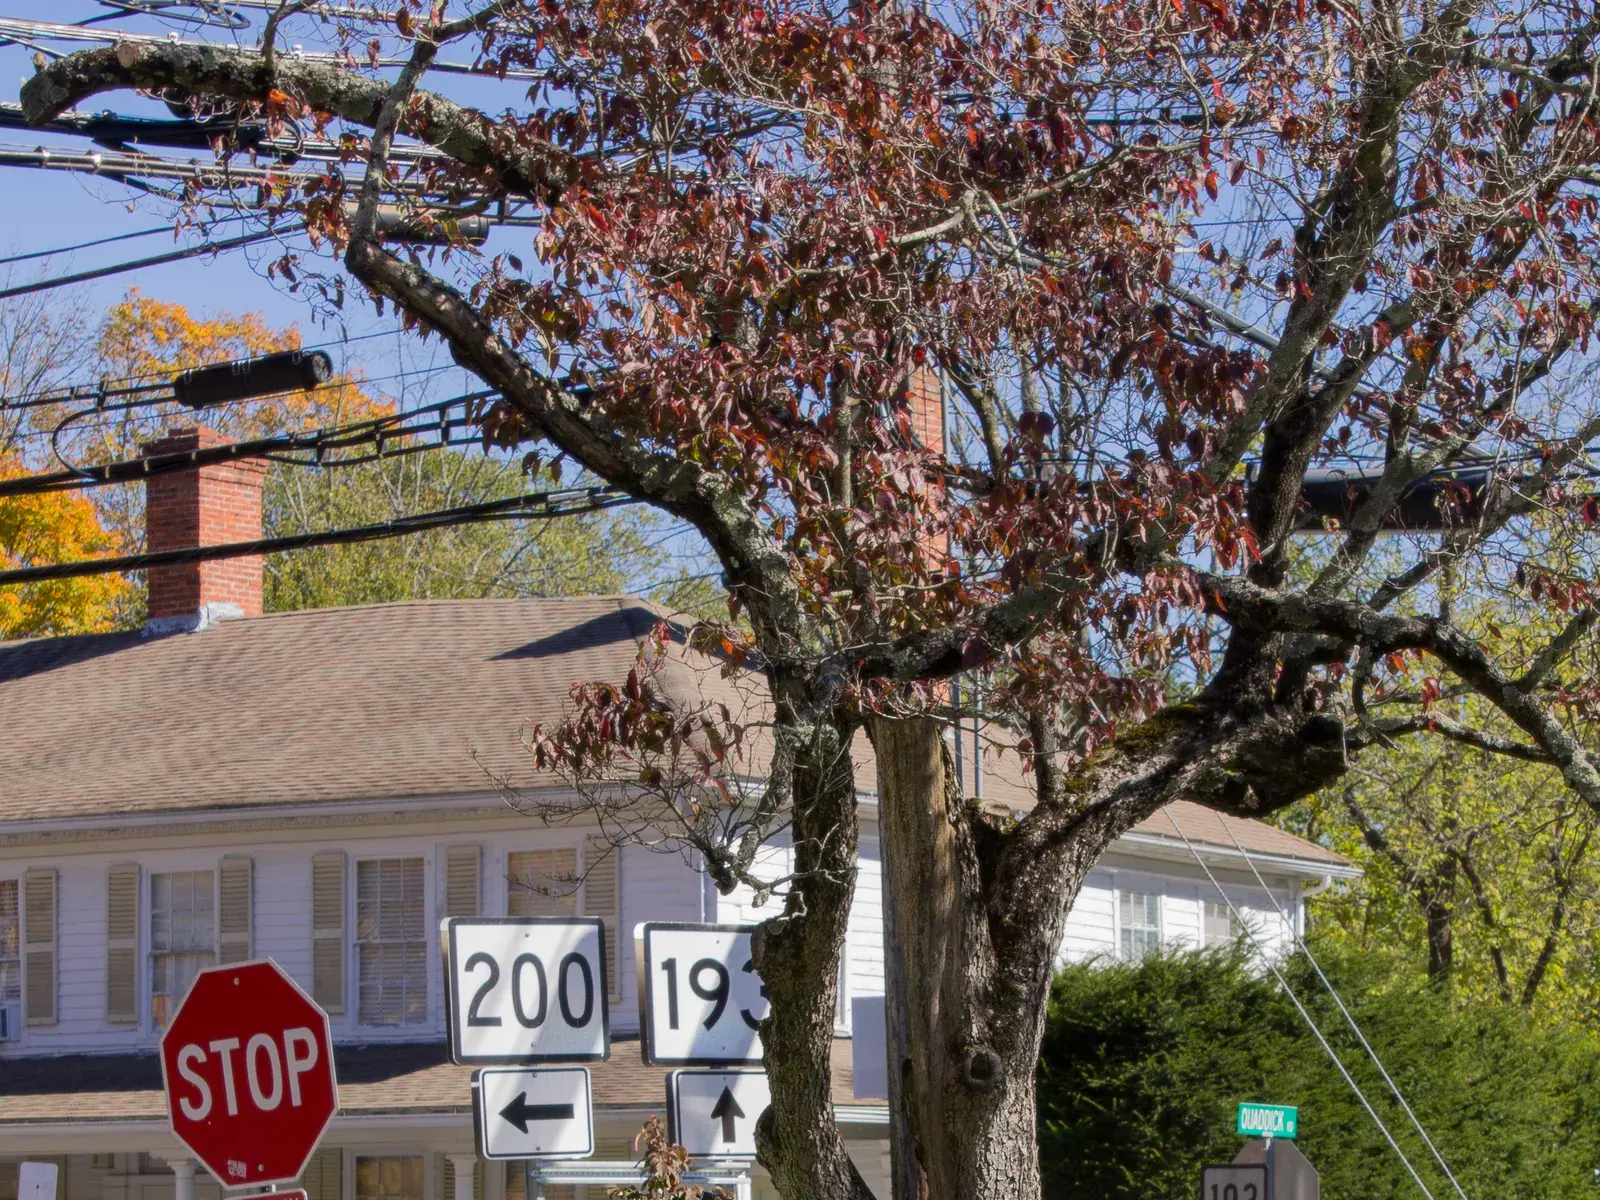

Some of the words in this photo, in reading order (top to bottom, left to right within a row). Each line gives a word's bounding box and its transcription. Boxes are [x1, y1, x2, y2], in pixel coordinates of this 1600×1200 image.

[464, 952, 594, 1029] 200
[177, 1026, 318, 1121] STOP
[1241, 1107, 1284, 1132] QUADDICK
